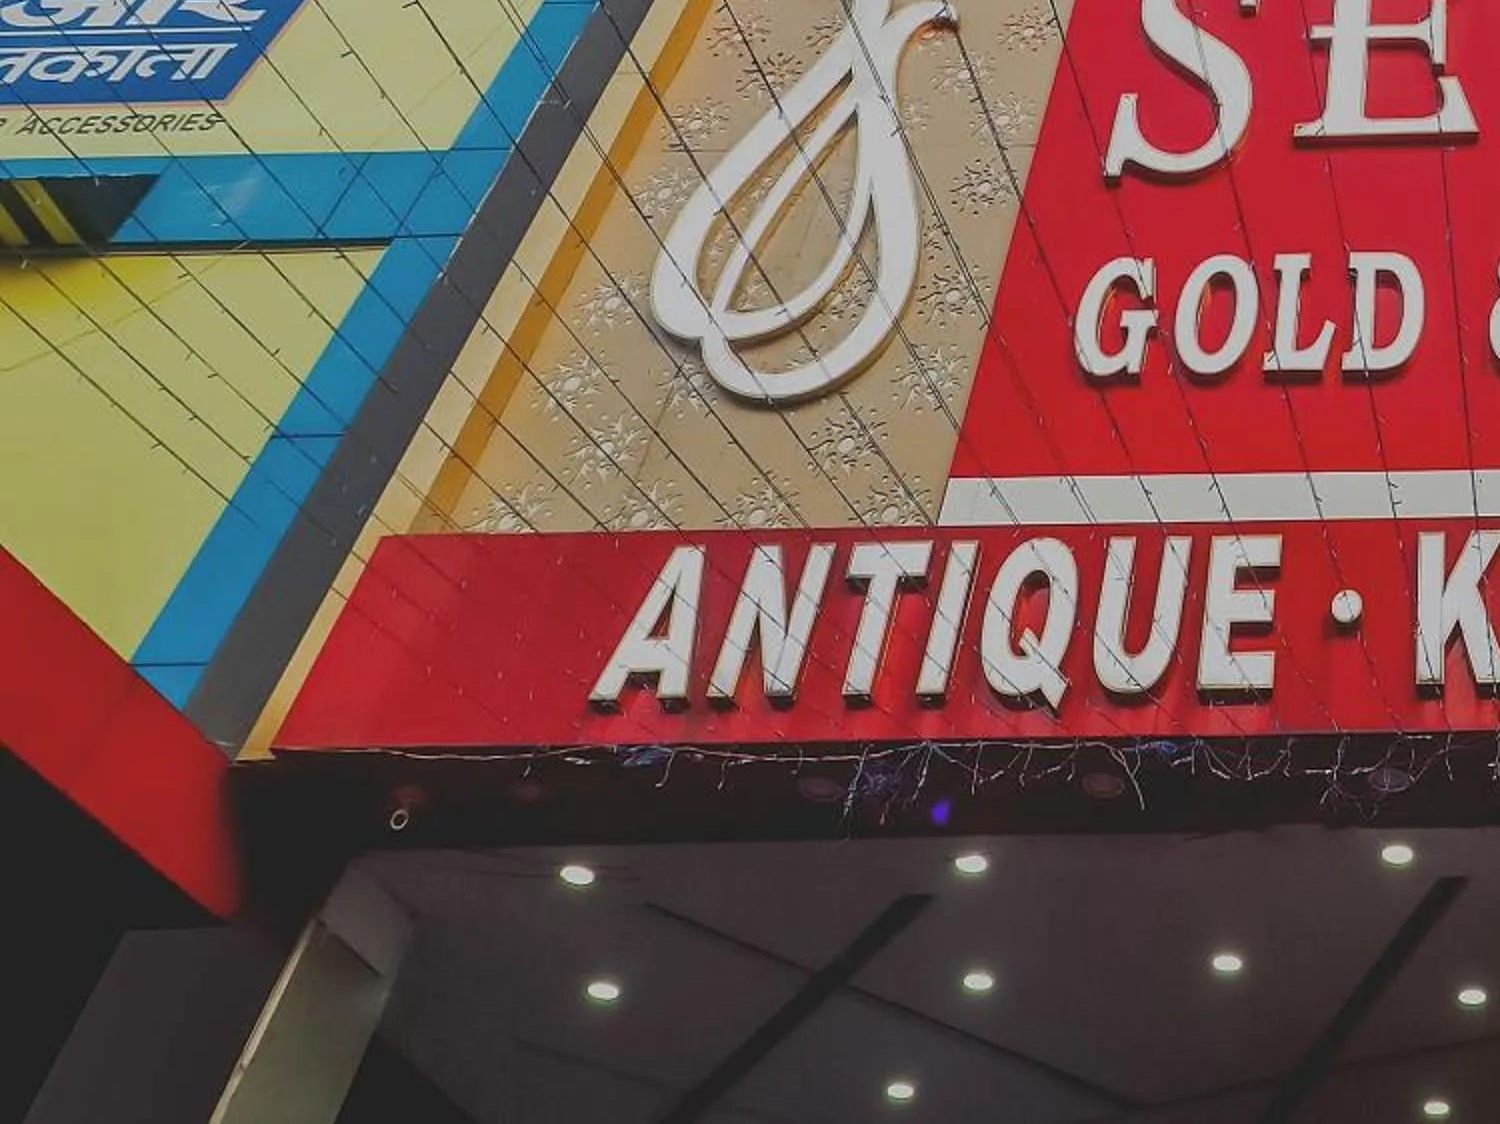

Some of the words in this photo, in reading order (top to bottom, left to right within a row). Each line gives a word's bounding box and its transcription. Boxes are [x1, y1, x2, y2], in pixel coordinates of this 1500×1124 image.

[16, 113, 219, 136] ACCESSORIES
[1073, 252, 1425, 380] GOLD
[588, 533, 1283, 708] ANTIQUE
